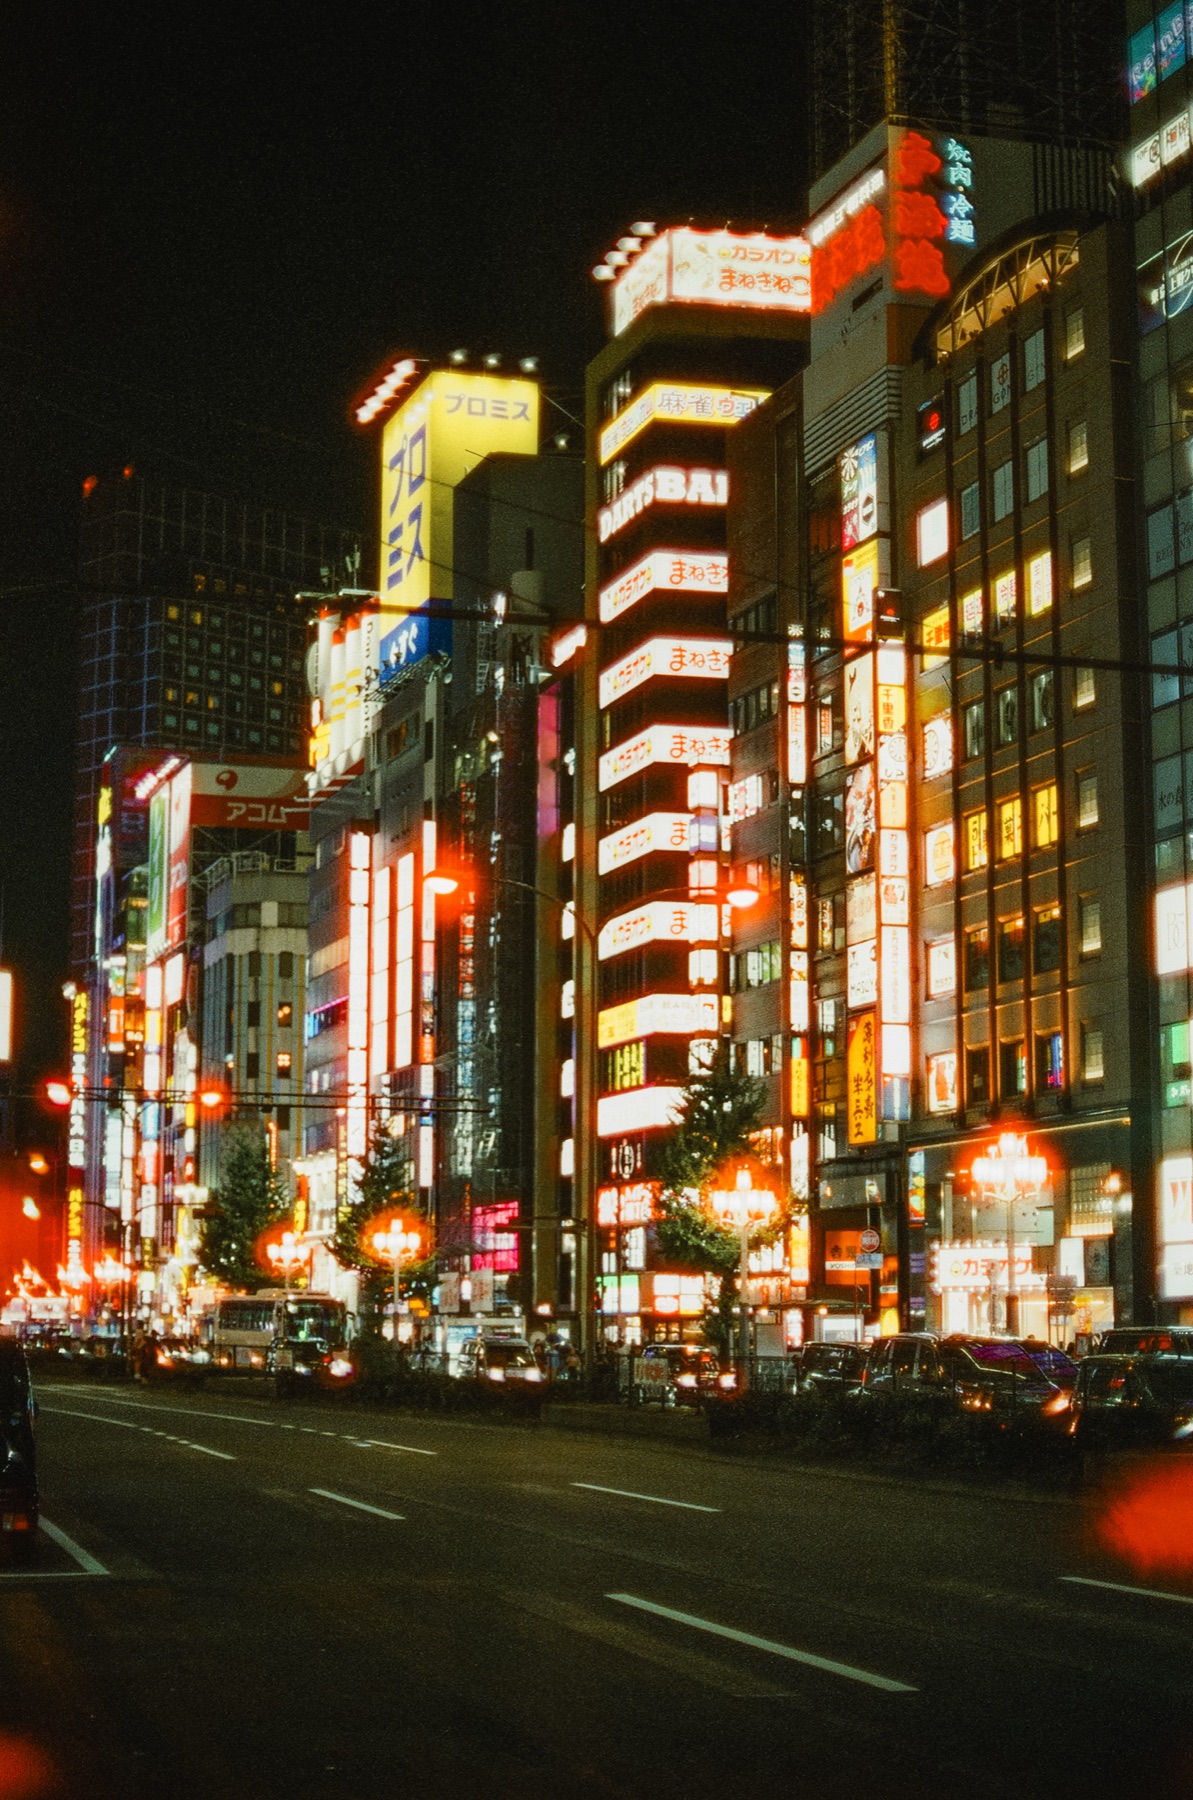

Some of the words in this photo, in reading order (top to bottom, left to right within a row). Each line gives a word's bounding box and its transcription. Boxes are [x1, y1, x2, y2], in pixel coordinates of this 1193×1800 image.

[718, 266, 810, 297] まねきねこ
[445, 394, 531, 422] プロミス
[600, 472, 654, 542] DARTS
[882, 688, 895, 730] 千里香
[227, 802, 288, 824] アコム
[73, 991, 87, 1053] パチンコ
